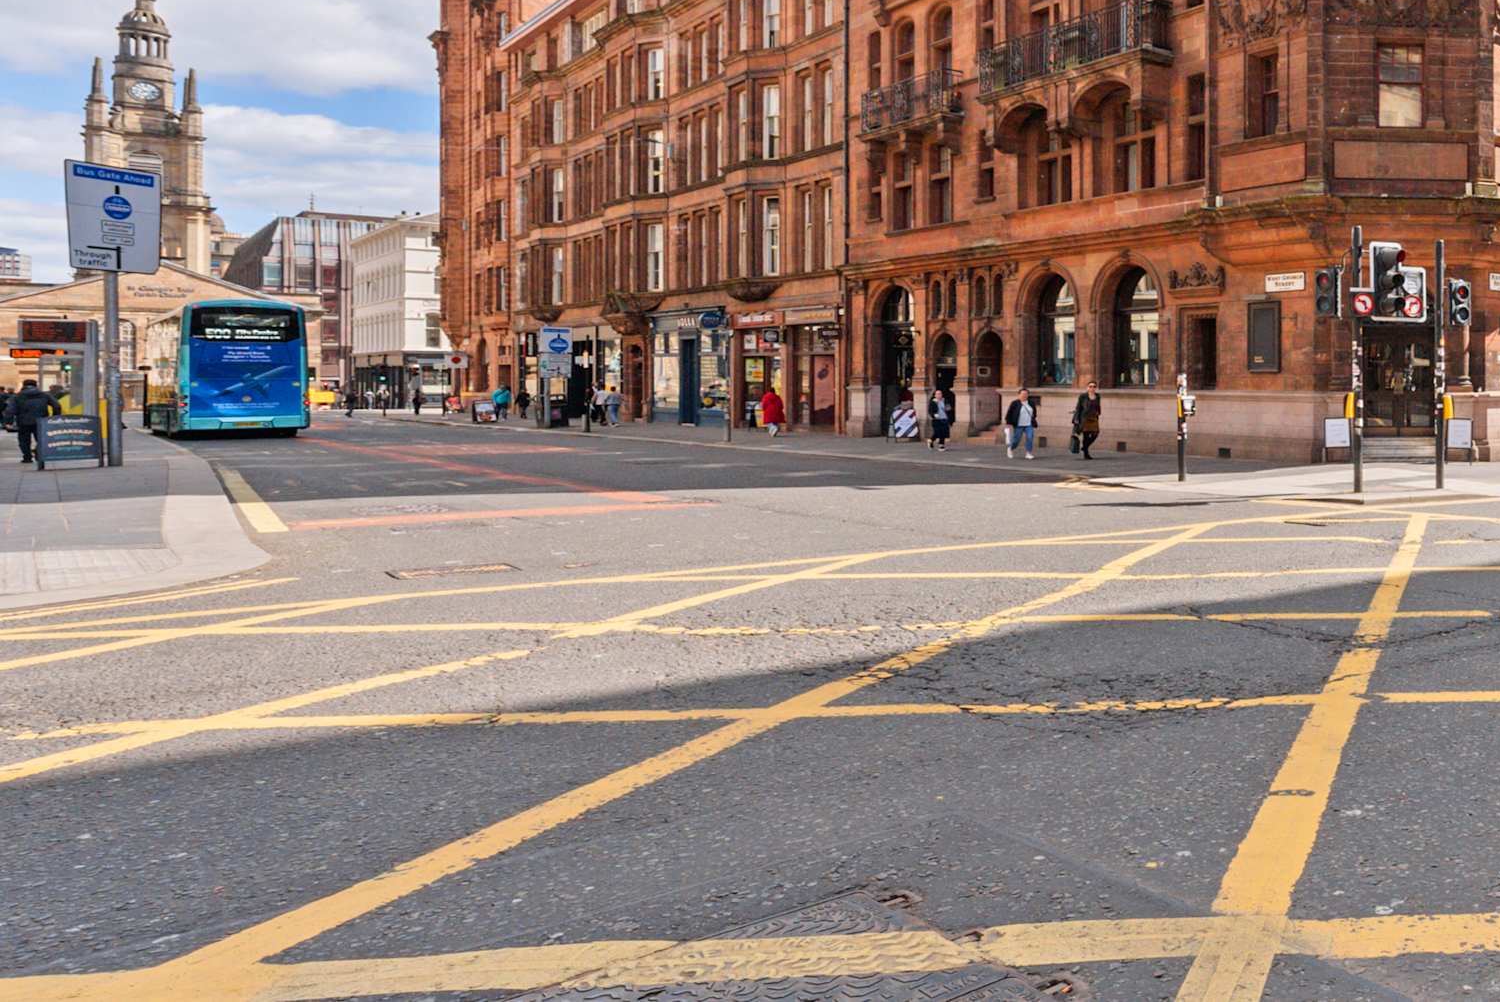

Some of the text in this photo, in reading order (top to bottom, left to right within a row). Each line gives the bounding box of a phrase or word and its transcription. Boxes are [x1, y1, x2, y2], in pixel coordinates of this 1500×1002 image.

[76, 166, 151, 185] Bus Gate Ahead
[74, 249, 112, 259] Through
[79, 258, 108, 267] traffic
